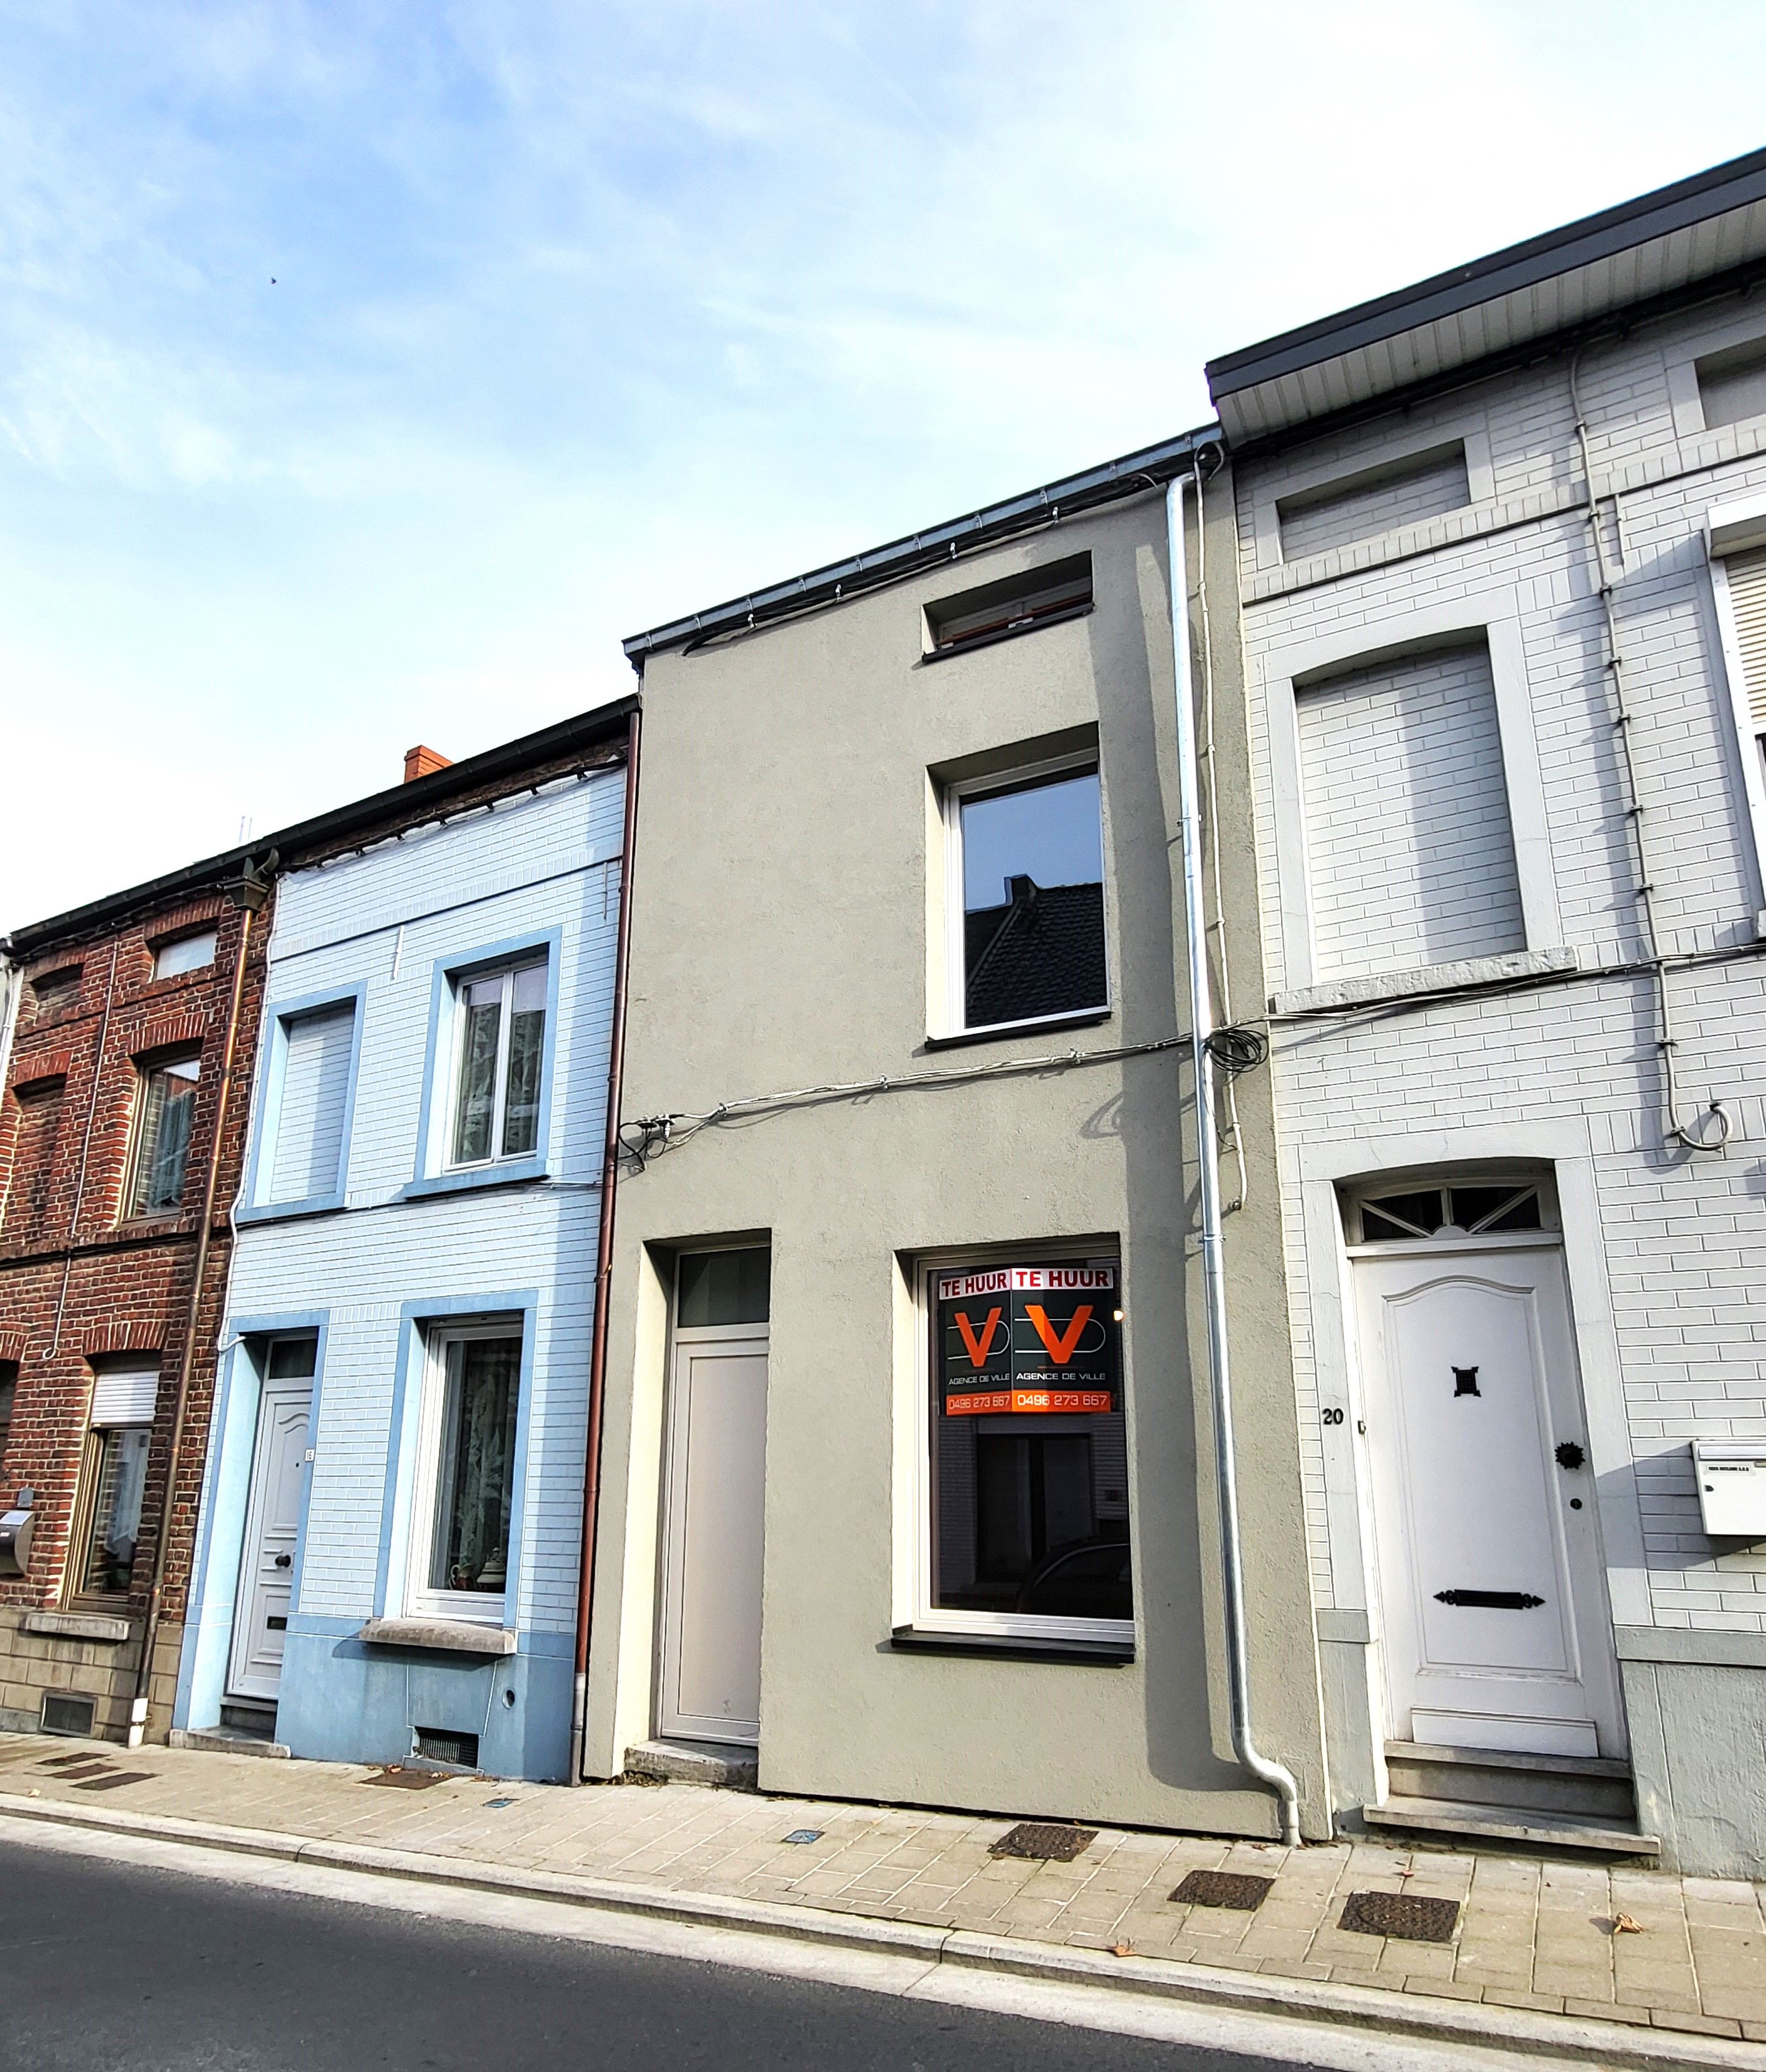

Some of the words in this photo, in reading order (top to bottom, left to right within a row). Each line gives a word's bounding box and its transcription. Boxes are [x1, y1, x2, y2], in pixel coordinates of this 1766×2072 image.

[942, 1280, 960, 1297] TE
[965, 1272, 1007, 1294] HUUR
[1015, 1271, 1041, 1287] TE
[1049, 1270, 1108, 1287] HUUR
[949, 1376, 977, 1385] AGENCE
[991, 1373, 1010, 1382] VILLE
[949, 1398, 971, 1410] 0496
[973, 1397, 990, 1407] 273
[1017, 1394, 1050, 1406] 0496
[1054, 1394, 1079, 1406] 273
[1083, 1394, 1107, 1406] 667
[1322, 1407, 1344, 1425] 20
